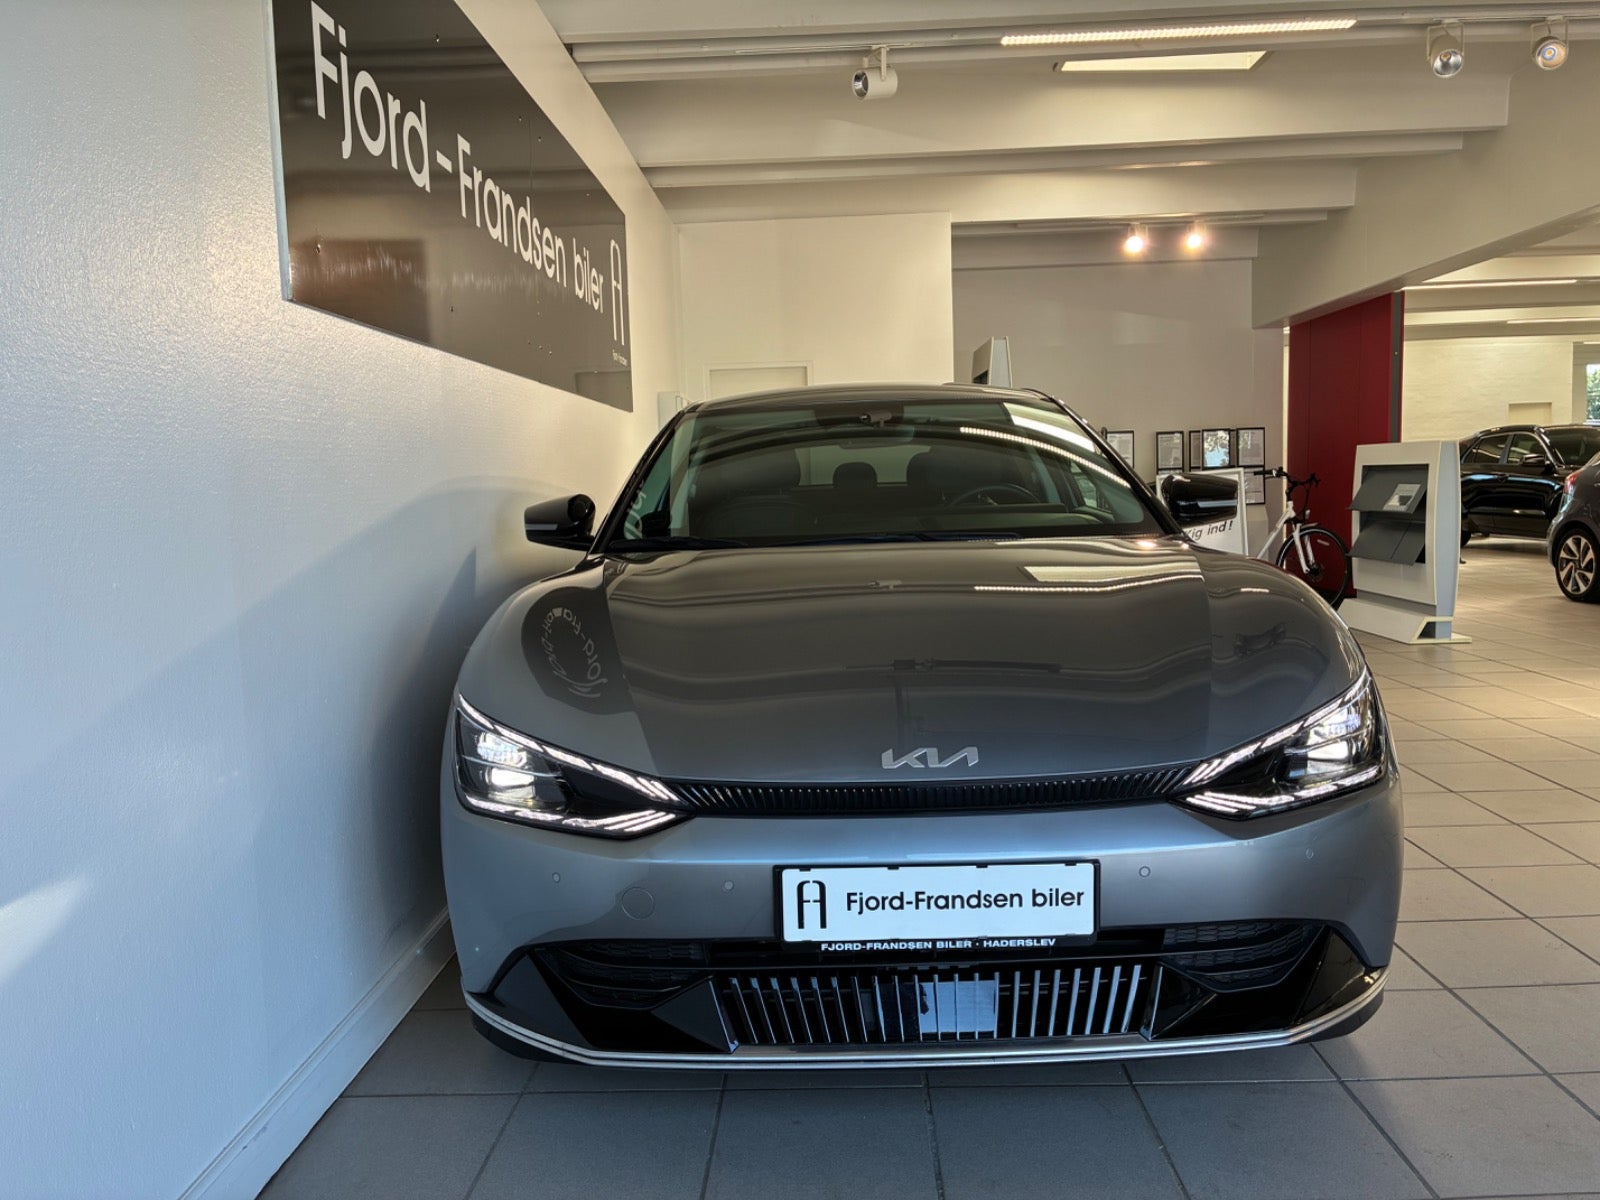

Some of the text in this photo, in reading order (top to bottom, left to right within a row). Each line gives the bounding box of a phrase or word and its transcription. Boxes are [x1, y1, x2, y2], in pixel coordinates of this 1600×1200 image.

[311, 1, 604, 314] Fjord-Frandsen biler
[881, 746, 979, 769] KIA
[846, 887, 1085, 915] Fjord-Frandsen biler
[820, 938, 1057, 951] FJORD-FRANDSEN BILER HADERSLEV
